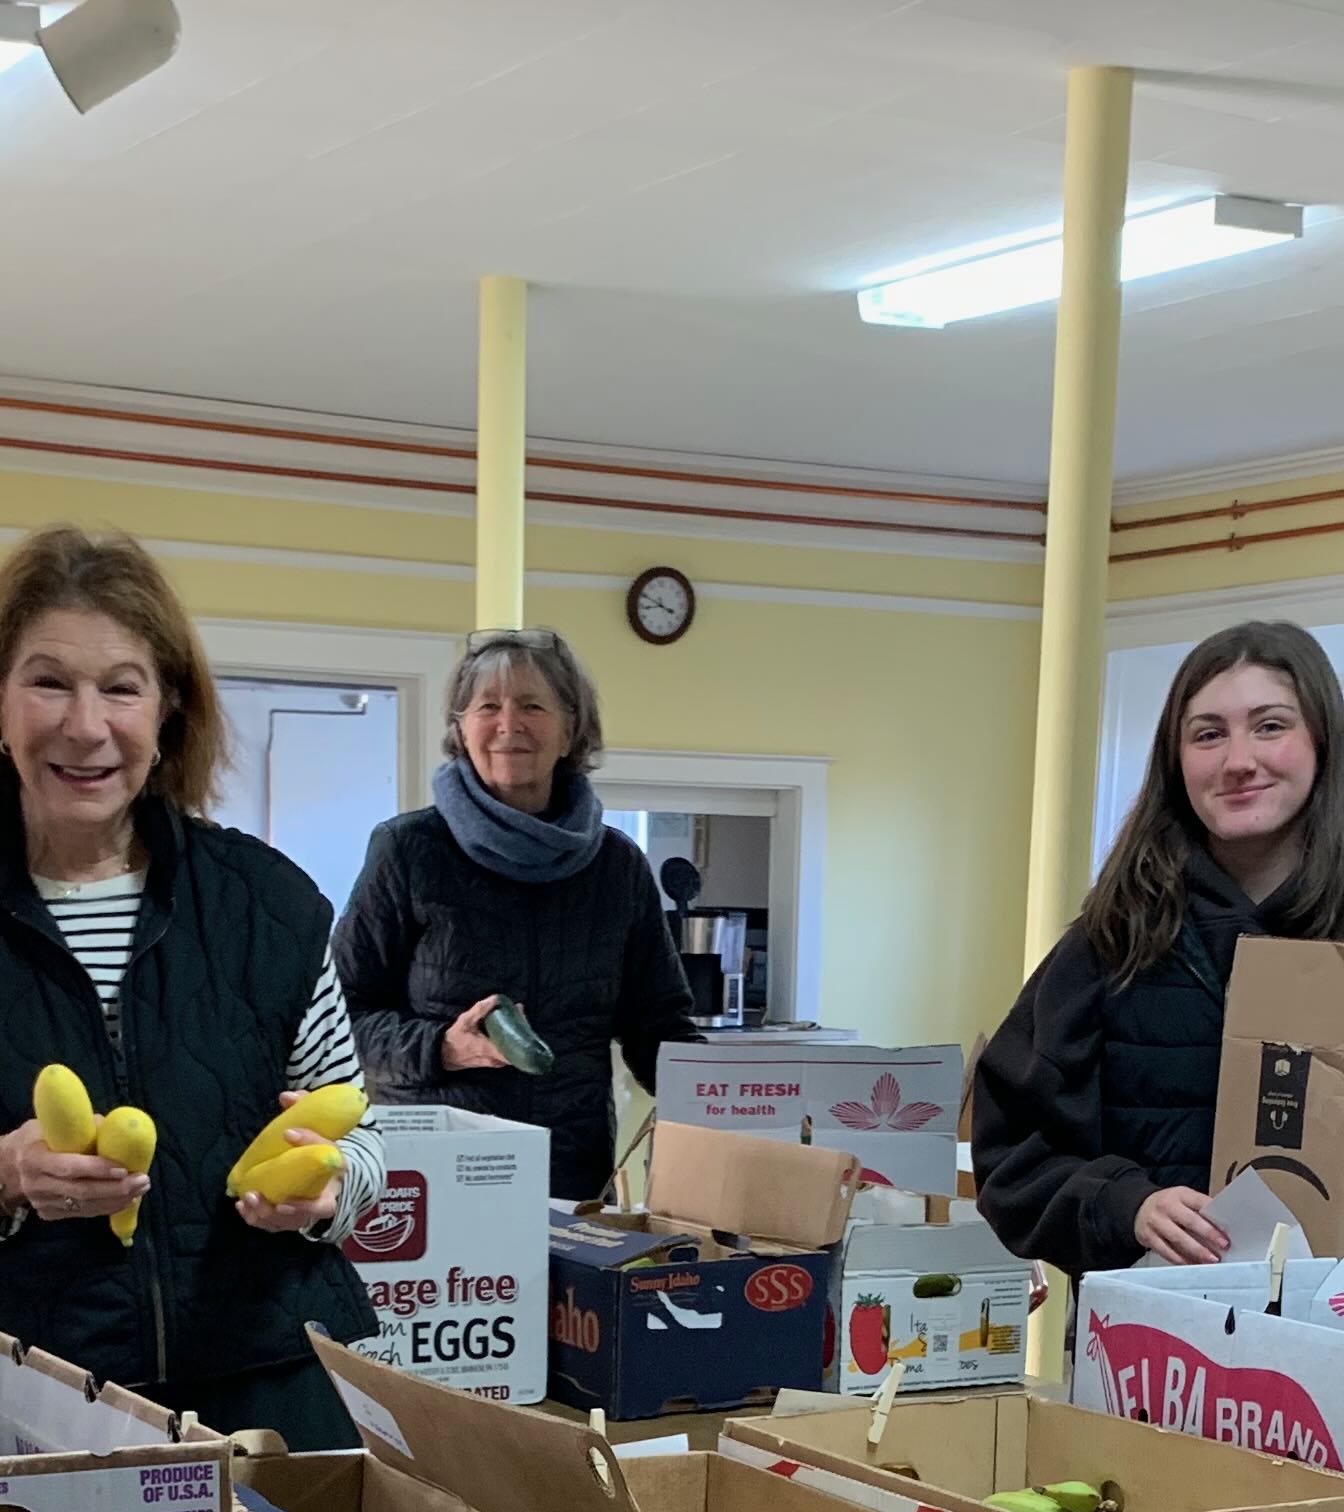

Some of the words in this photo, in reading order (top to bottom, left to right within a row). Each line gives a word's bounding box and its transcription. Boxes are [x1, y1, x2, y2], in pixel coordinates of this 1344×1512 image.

[696, 1083, 729, 1097] EAT
[739, 1083, 800, 1097] FRESH
[706, 1104, 726, 1115] for
[731, 1104, 776, 1116] health
[368, 1278, 438, 1317] age
[446, 1266, 516, 1304] free
[754, 1269, 804, 1305] SSS
[411, 1316, 516, 1364] EGGS
[1215, 1397, 1329, 1468] BRAND
[139, 1464, 214, 1487] PRODUCE
[143, 1485, 165, 1503] OF
[167, 1482, 214, 1501] U.S.A.
